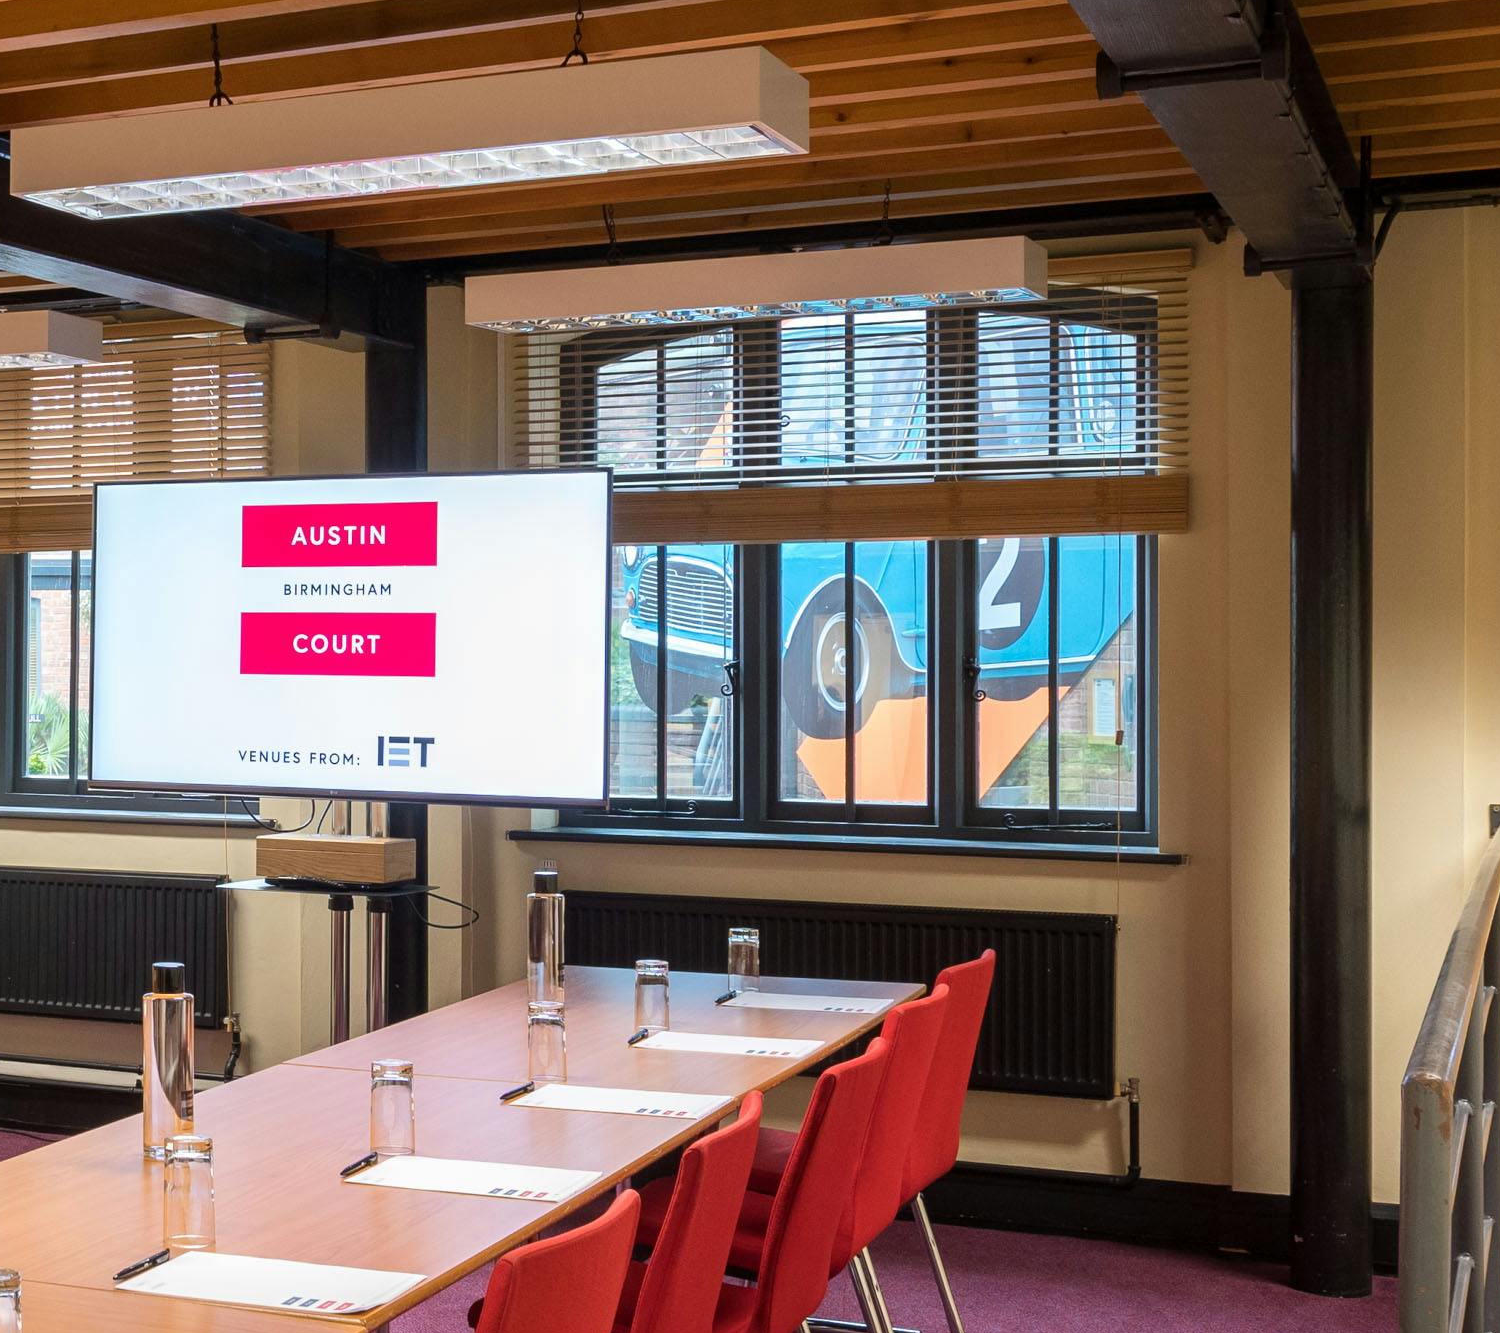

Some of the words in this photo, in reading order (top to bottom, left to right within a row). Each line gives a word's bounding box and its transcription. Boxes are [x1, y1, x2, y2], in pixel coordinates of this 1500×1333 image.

[291, 525, 386, 546] AUSTIN
[283, 584, 392, 596] BIRMINGHAM
[292, 634, 382, 654] COURT
[238, 750, 301, 764] VENUES
[309, 752, 360, 765] FROM:
[377, 736, 435, 767] IET
